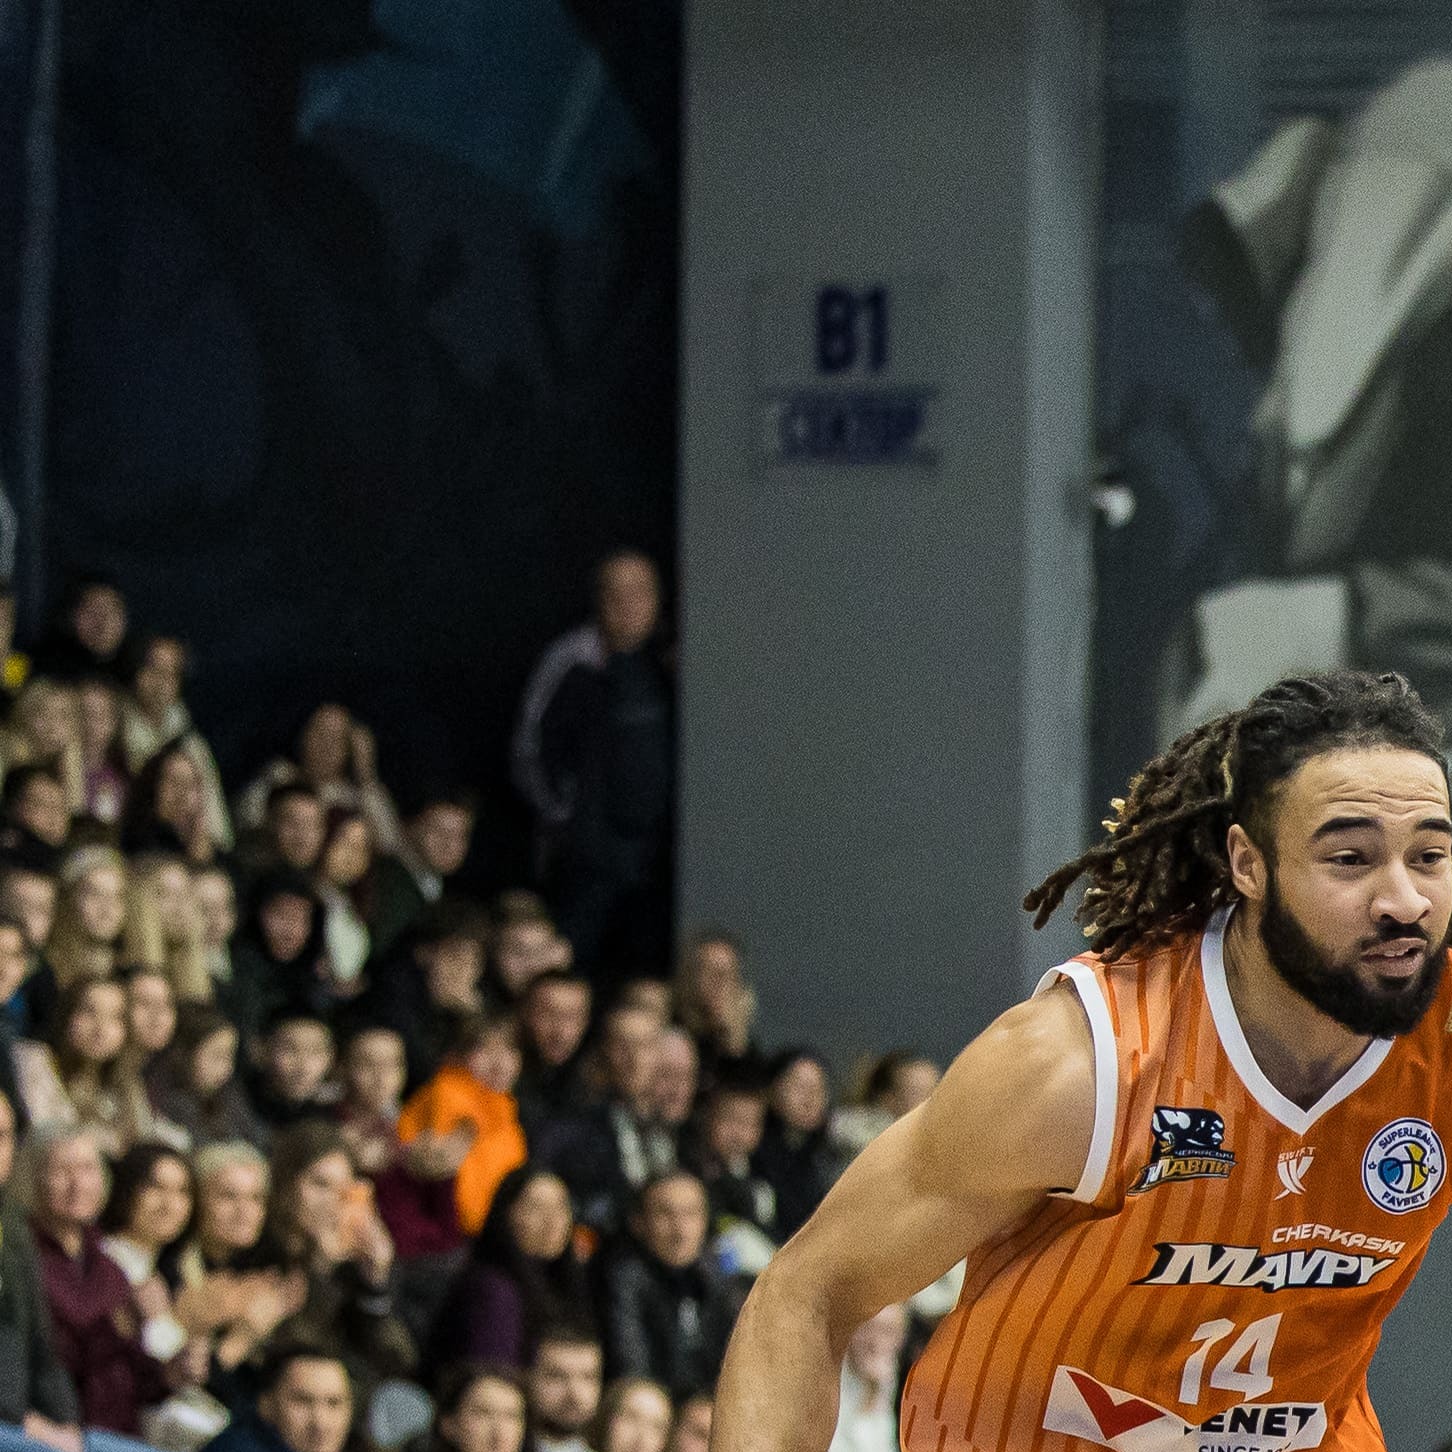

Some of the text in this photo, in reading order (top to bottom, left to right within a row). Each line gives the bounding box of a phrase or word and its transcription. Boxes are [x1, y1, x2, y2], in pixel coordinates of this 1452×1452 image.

[1271, 1223, 1406, 1254] CHERKASKI
[1138, 1242, 1396, 1292] MAVPY
[1178, 1312, 1284, 1406] 14
